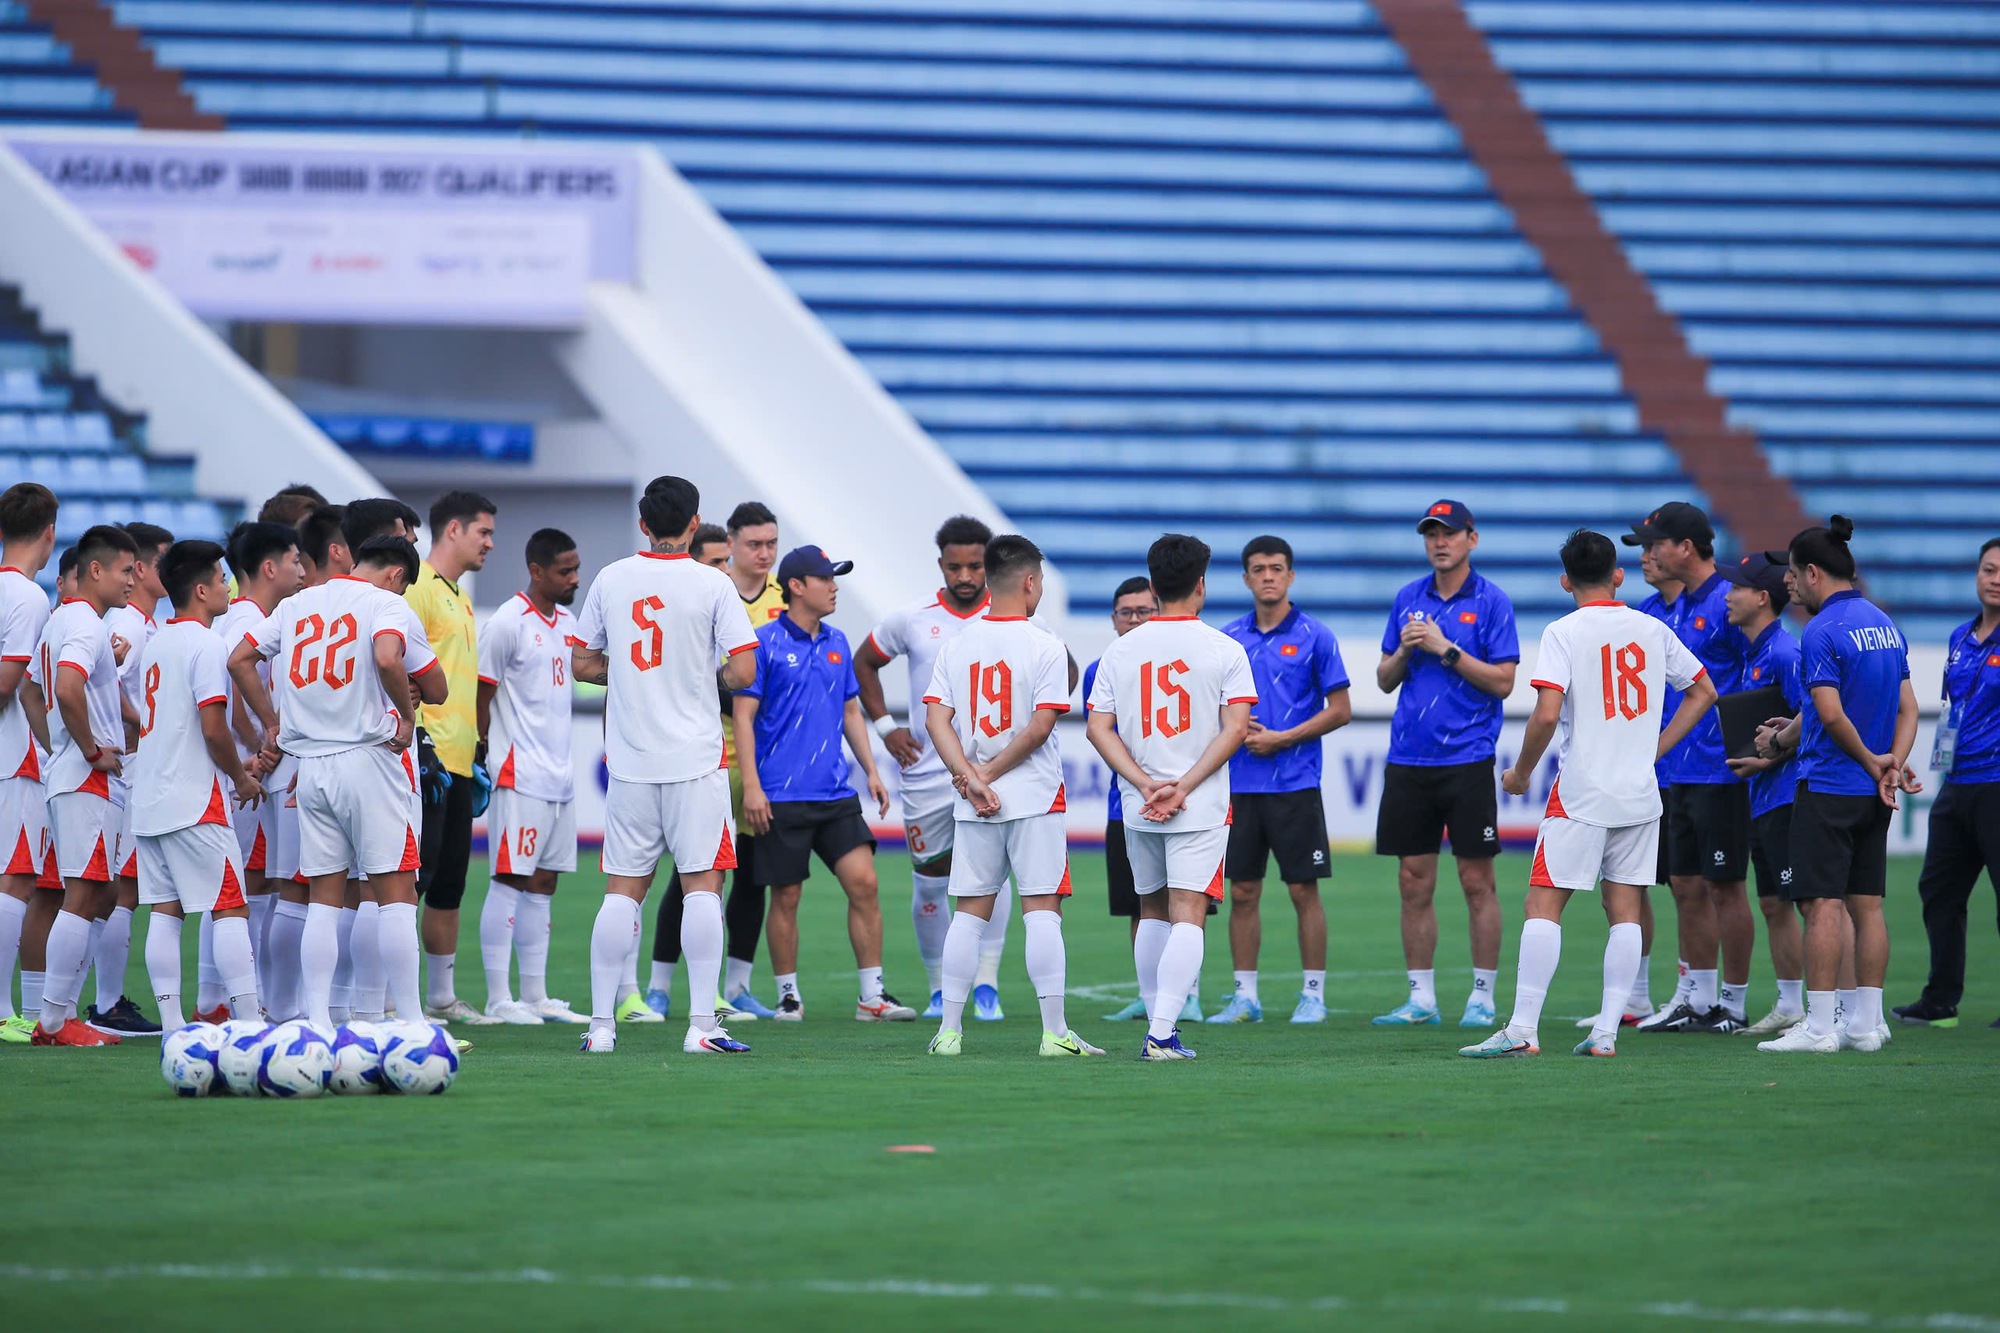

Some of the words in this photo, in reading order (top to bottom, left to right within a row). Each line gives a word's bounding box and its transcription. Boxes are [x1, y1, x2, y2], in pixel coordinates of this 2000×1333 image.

[159, 158, 227, 193] CUP
[289, 612, 357, 690] 22
[552, 657, 564, 686] 13
[631, 595, 665, 671] 5
[970, 659, 1012, 738] 19
[1140, 658, 1191, 739] 15
[1600, 641, 1648, 721] 18
[517, 826, 537, 857] 13
